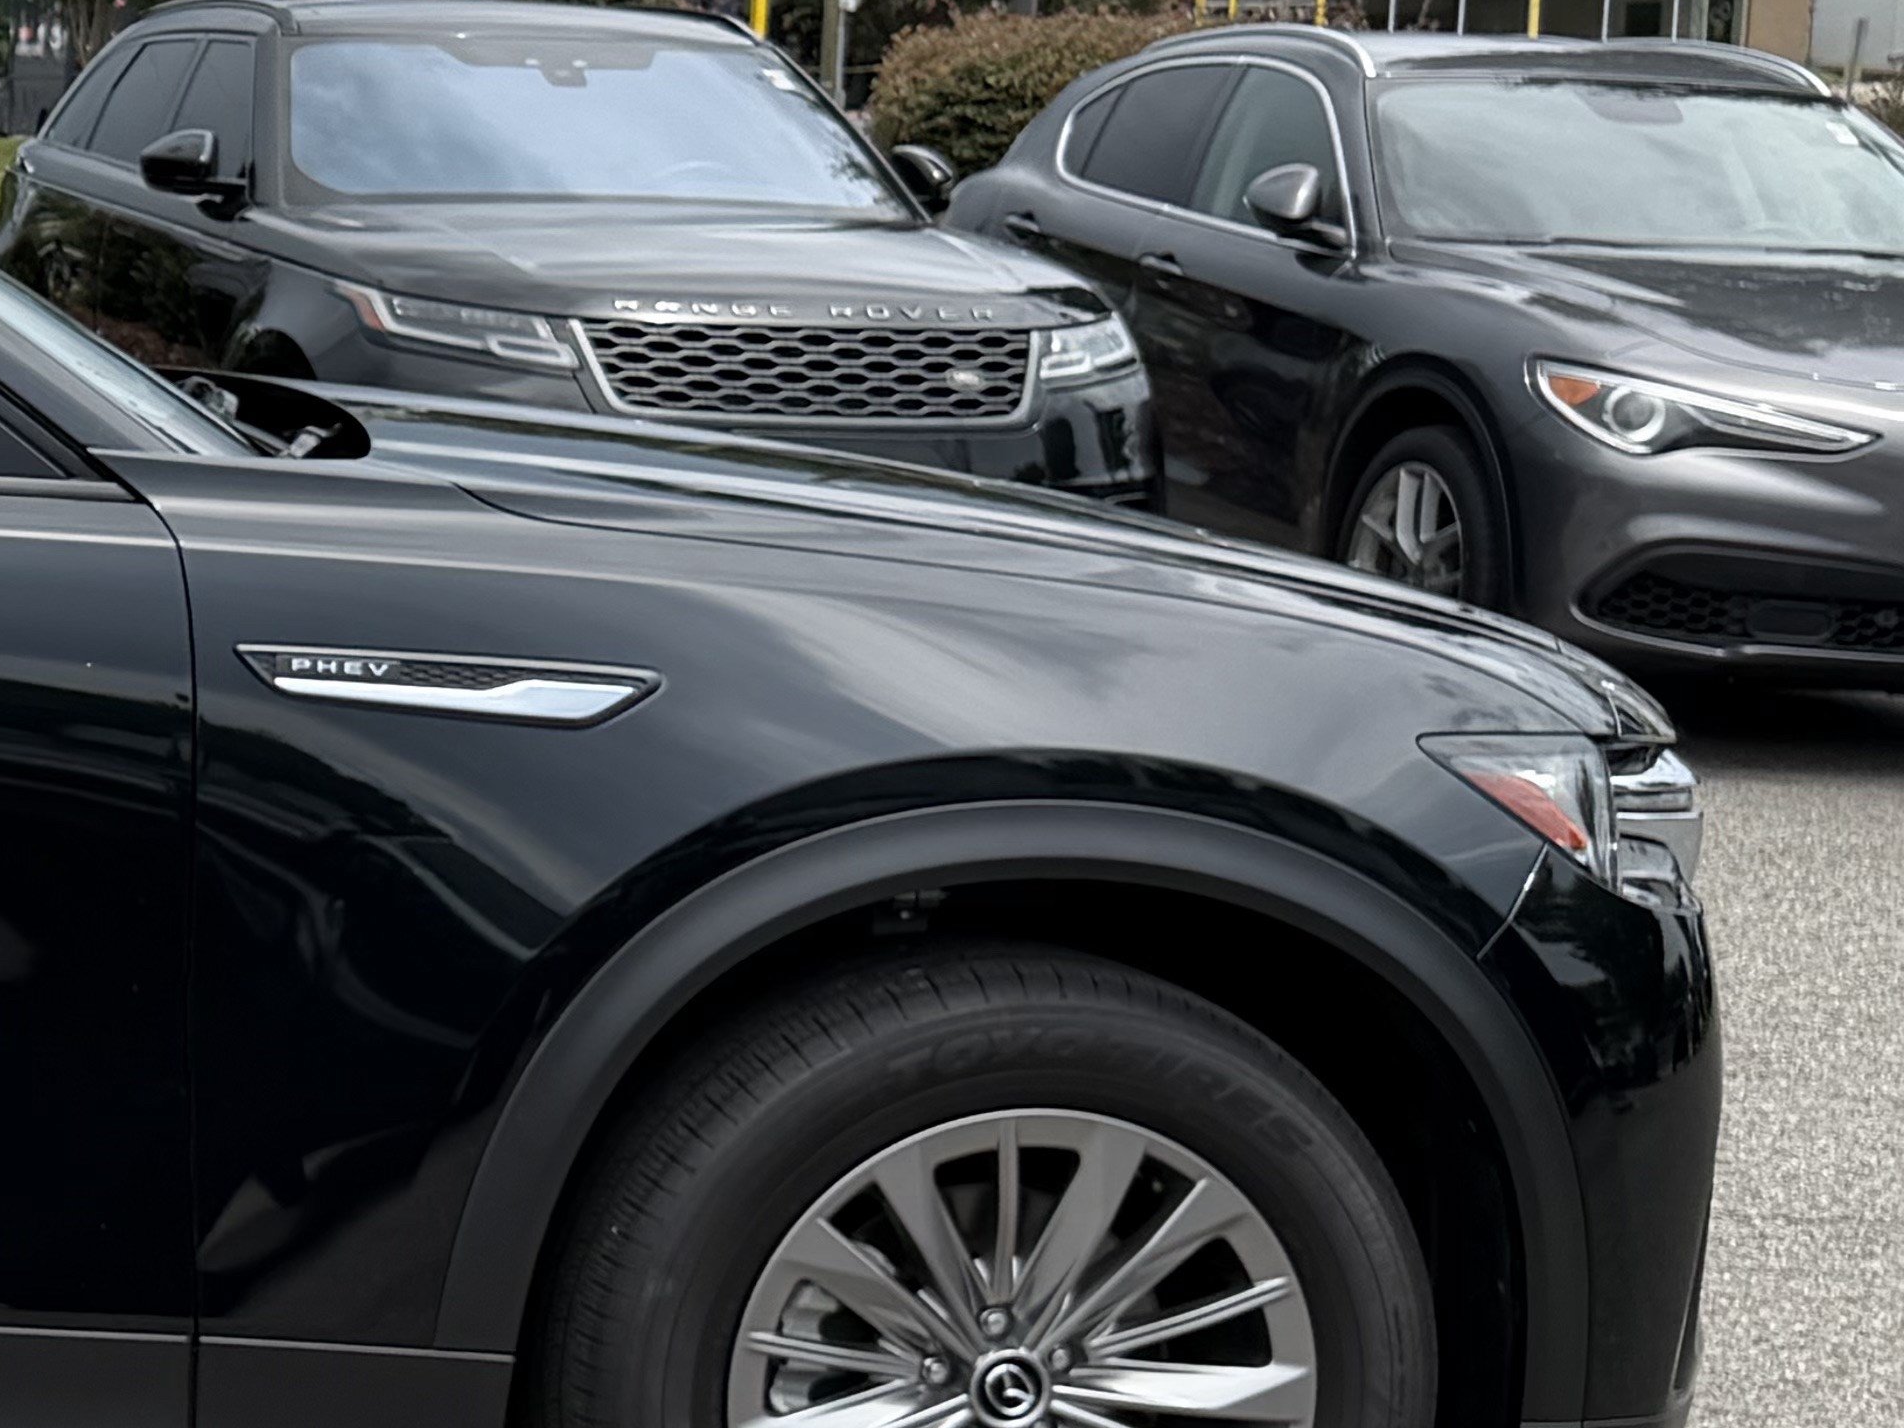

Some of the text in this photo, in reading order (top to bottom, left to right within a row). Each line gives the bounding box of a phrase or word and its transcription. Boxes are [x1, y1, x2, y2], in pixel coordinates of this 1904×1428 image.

[614, 299, 993, 322] RANGE ROVER
[291, 657, 389, 677] PHEV
